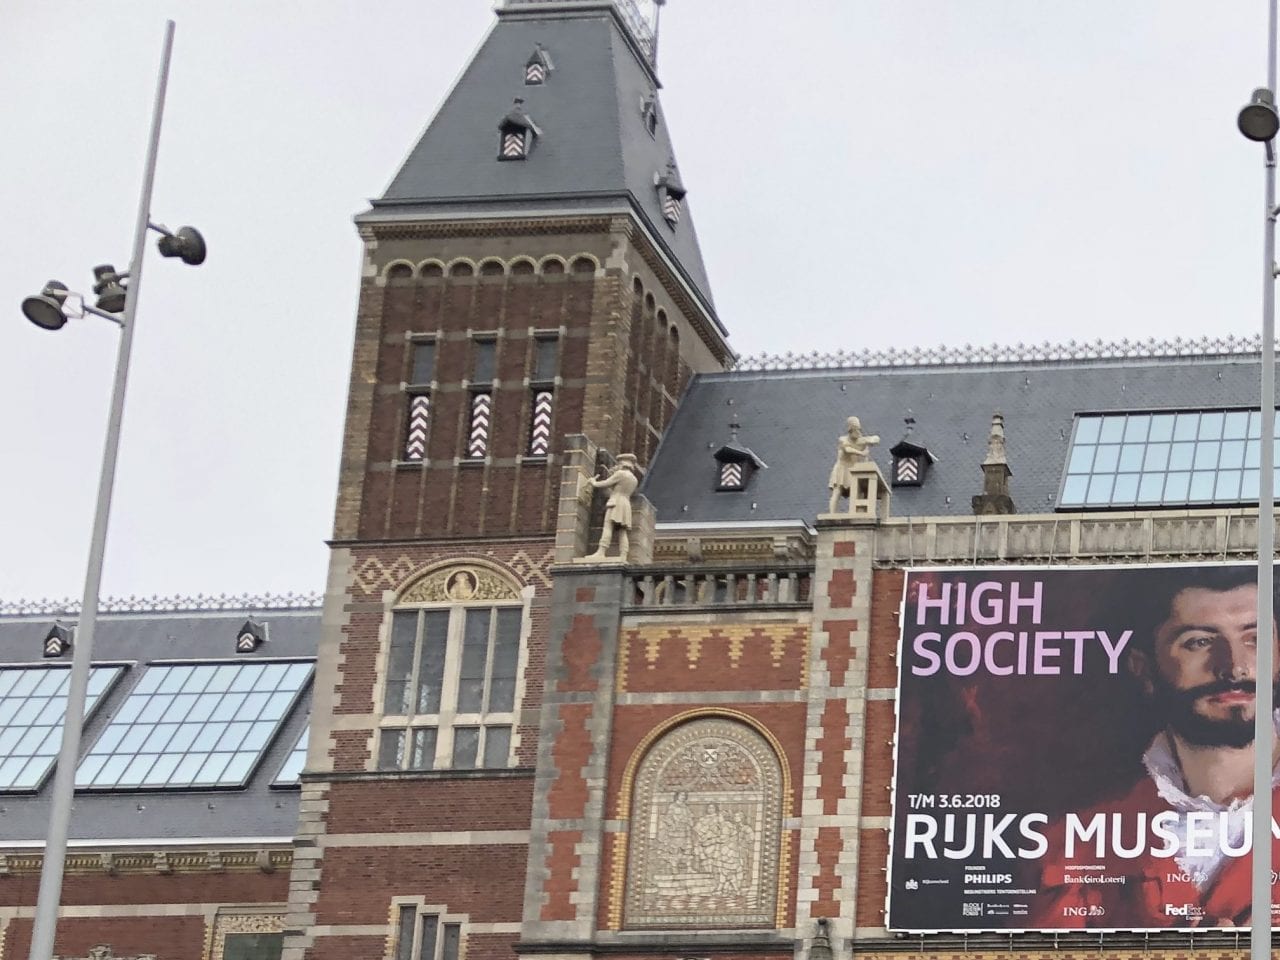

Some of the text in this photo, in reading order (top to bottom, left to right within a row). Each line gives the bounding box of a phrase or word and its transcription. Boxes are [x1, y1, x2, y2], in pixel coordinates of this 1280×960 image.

[915, 580, 1044, 626] HIGH
[911, 629, 1134, 677] SOCIETY
[908, 793, 1001, 808] T/M 3.6.2018
[964, 874, 1013, 884] PHILIPS
[1064, 874, 1126, 885] BankGiroLoterij
[1166, 873, 1191, 883] ING
[1063, 907, 1087, 916] ING
[1165, 903, 1202, 916] FedEx
